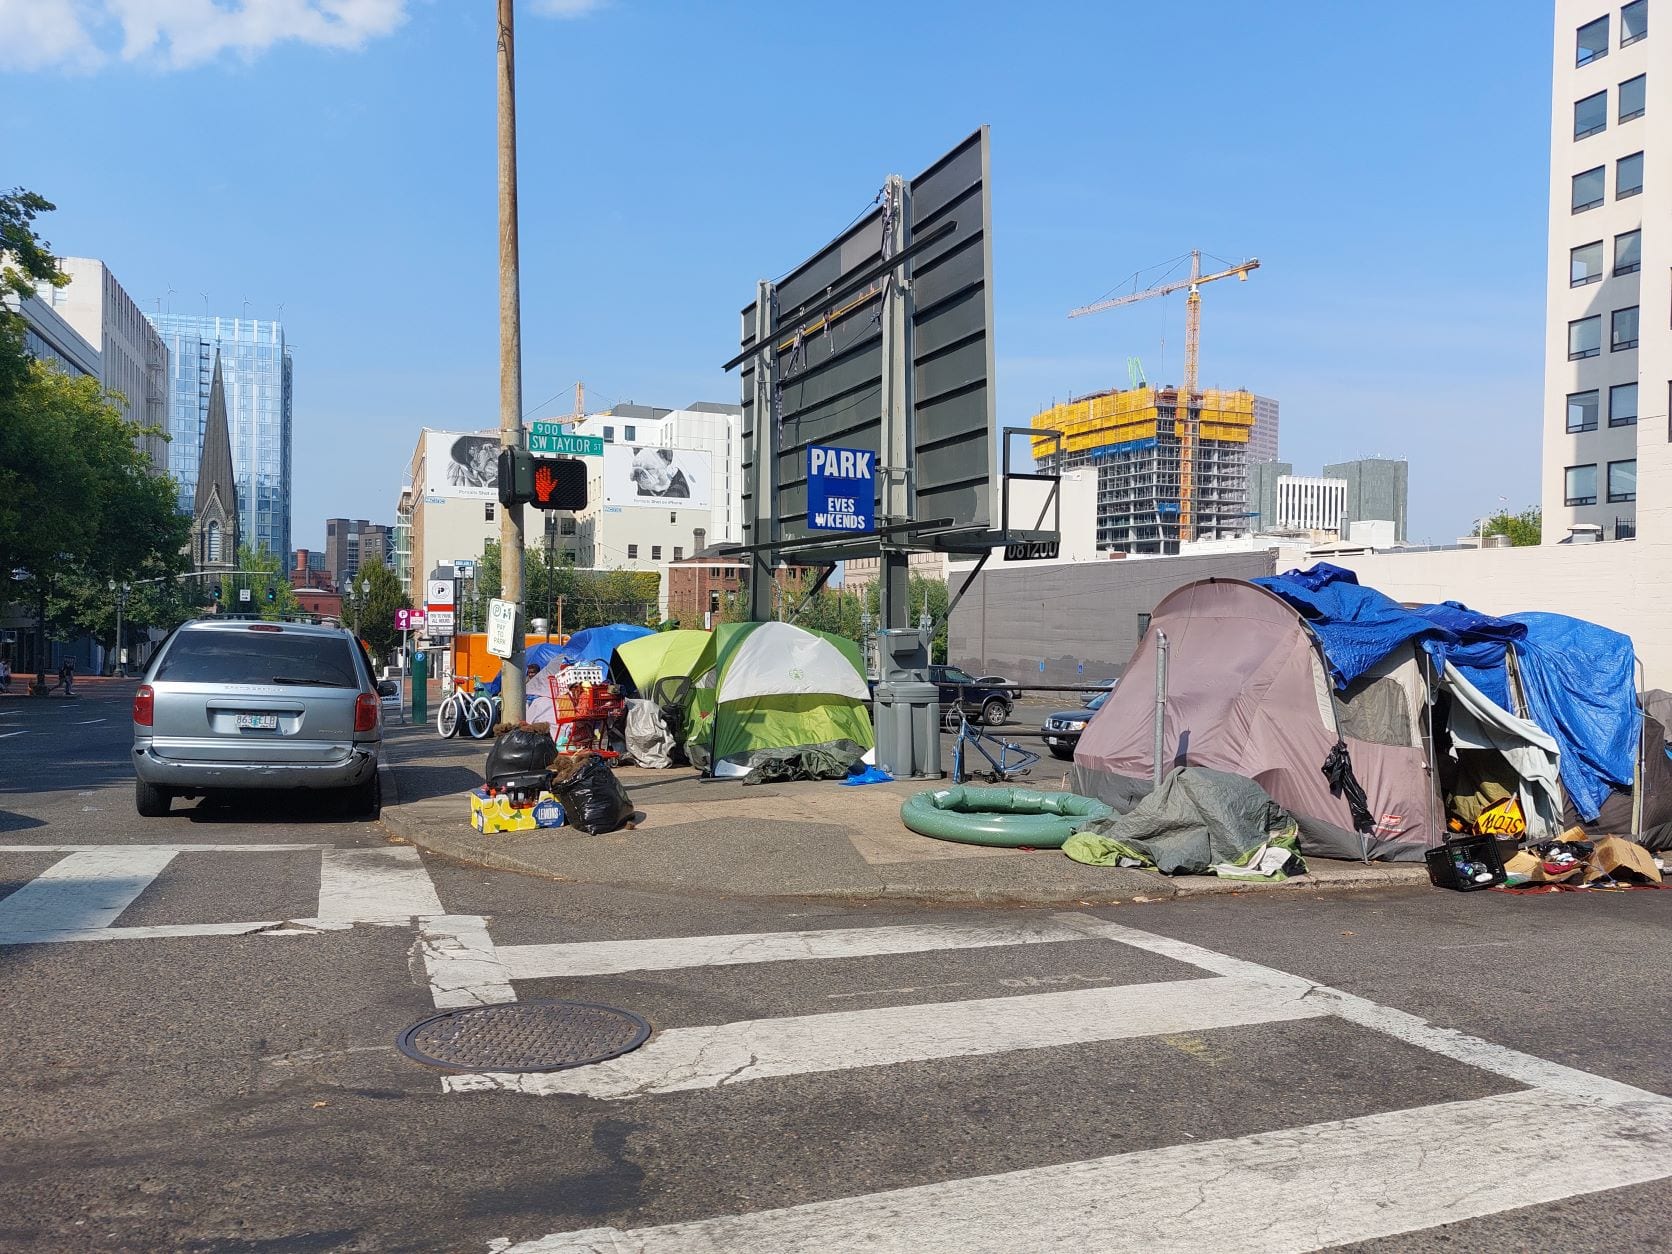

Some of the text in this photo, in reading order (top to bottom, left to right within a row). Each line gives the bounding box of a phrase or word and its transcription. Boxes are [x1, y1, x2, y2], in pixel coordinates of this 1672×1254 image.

[537, 423, 558, 435] 900
[532, 435, 602, 453] SW TAYLOR ST
[811, 448, 871, 479] PARK
[827, 497, 855, 513] EVES
[815, 512, 866, 530] WKENDS
[400, 619, 406, 627] 4
[494, 636, 505, 644] PARK
[497, 630, 504, 638] TO
[538, 807, 559, 820] LEMONS
[1481, 813, 1523, 834] SLOW
